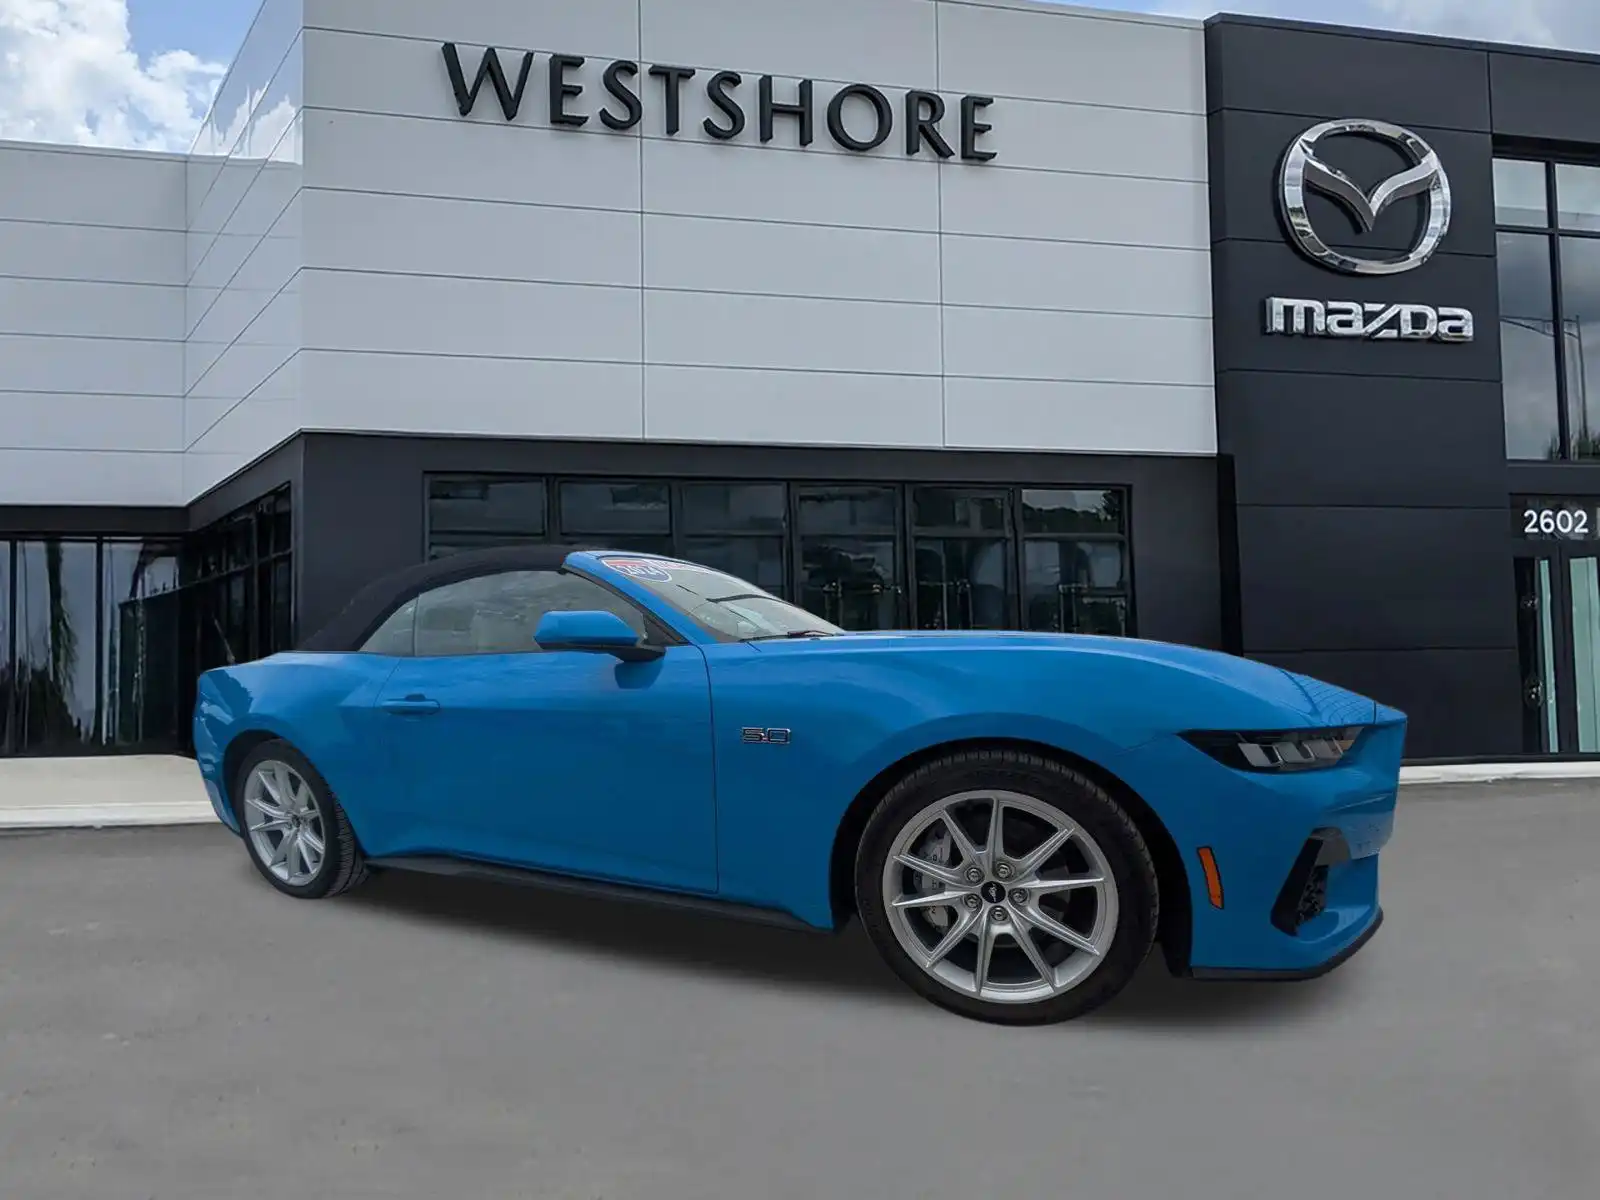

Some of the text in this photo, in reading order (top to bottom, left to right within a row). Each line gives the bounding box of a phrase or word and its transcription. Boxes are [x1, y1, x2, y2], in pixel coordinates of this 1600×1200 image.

[442, 42, 998, 162] WESTSHORE
[1523, 509, 1589, 533] 2602
[741, 726, 791, 744] 5.0
